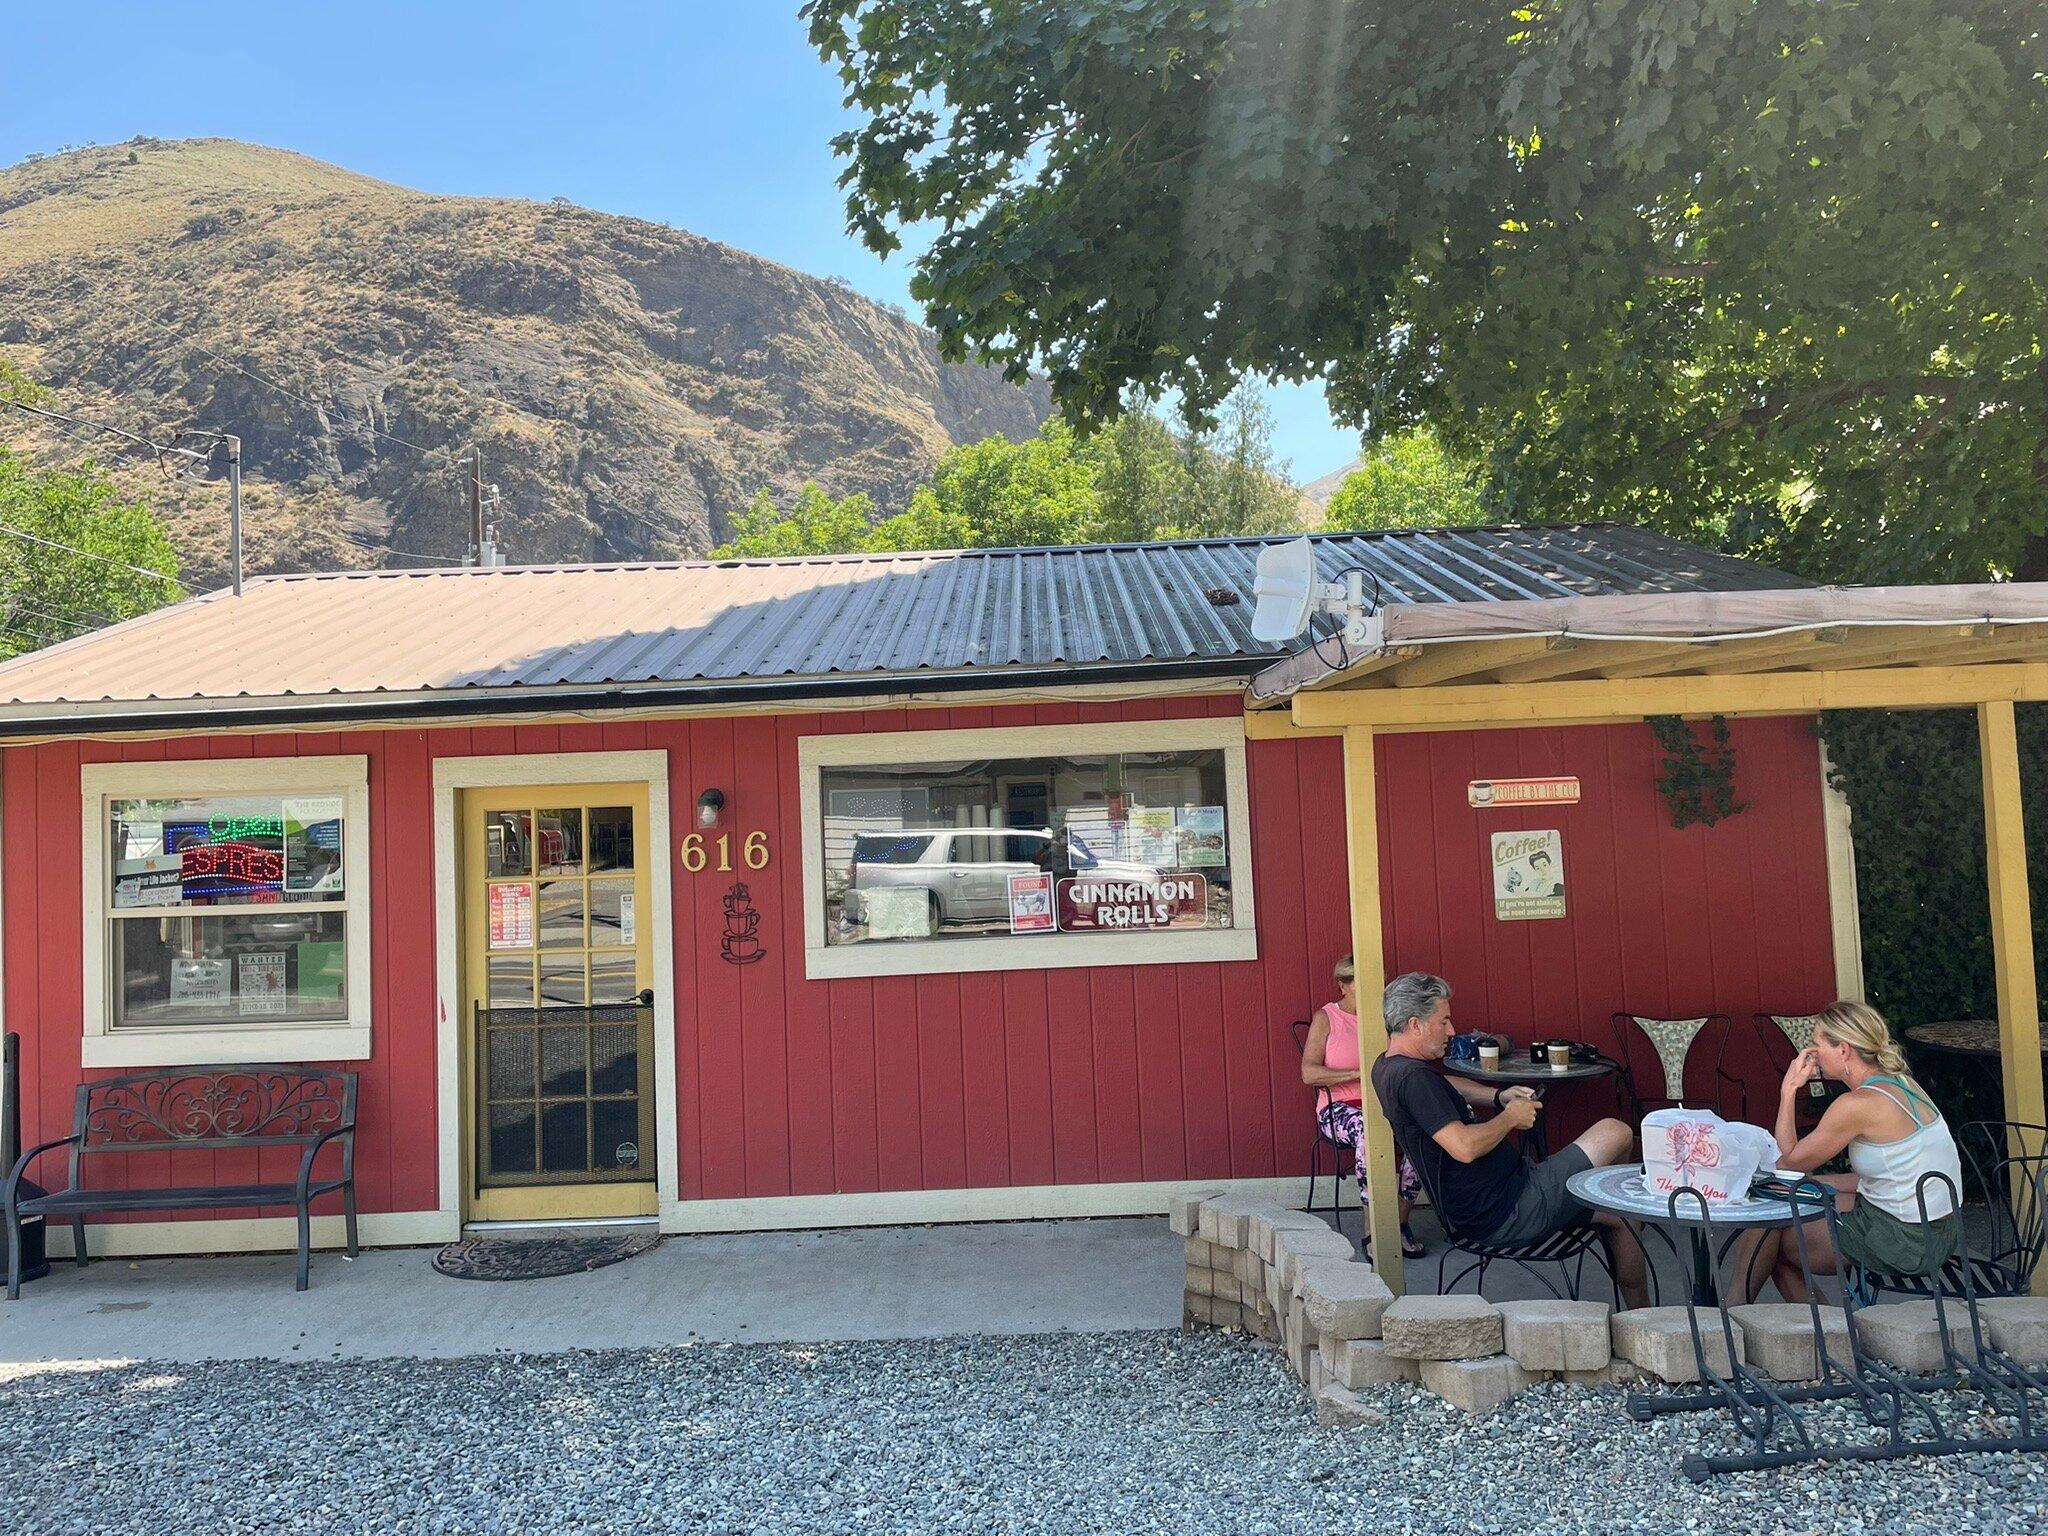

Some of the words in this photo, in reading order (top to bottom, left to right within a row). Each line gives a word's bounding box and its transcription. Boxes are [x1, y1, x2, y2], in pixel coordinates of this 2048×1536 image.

[1498, 786, 1527, 799] COFFEE
[1530, 786, 1540, 798] BY
[1544, 785, 1560, 798] THE
[1563, 784, 1577, 796] CUP
[208, 812, 281, 840] Open
[681, 831, 769, 872] 616
[1495, 831, 1552, 862] Coffee!
[182, 847, 284, 879] ESPRES
[1068, 881, 1194, 903] CINNAMON
[1098, 904, 1169, 927] ROLLS
[1657, 1178, 1693, 1191] Tha
[1702, 1184, 1728, 1199] You
